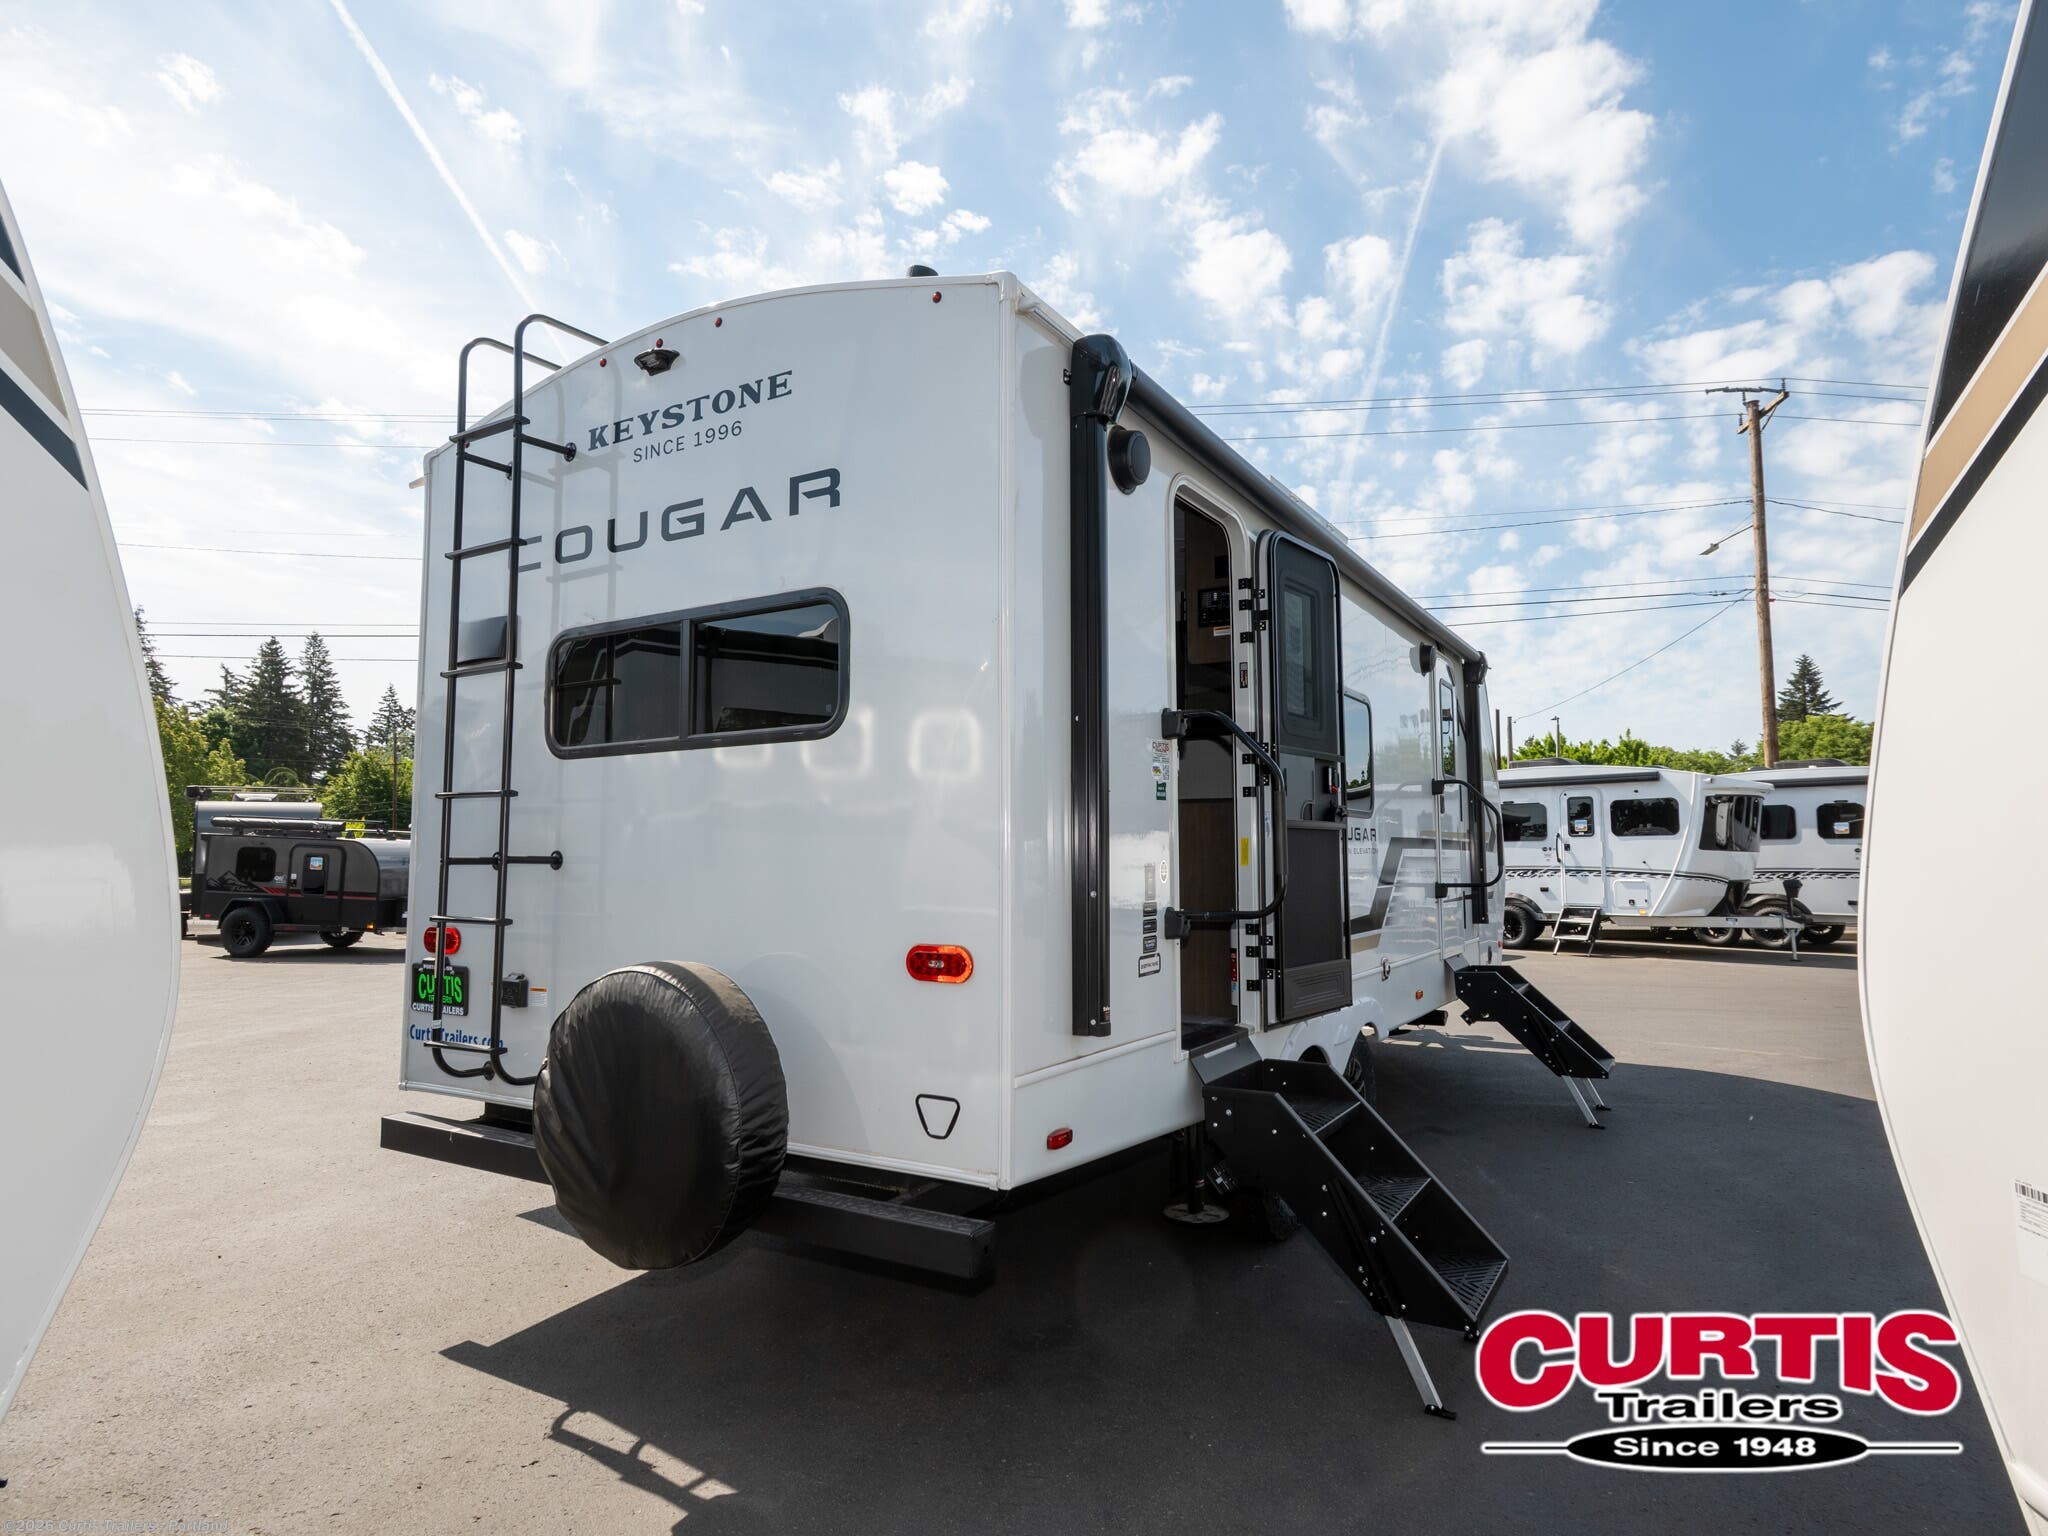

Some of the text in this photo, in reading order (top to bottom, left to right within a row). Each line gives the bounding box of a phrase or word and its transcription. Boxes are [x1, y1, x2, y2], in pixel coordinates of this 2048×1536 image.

[588, 370, 793, 451] KEYSTONE
[633, 420, 742, 463] SINCE 1996
[418, 973, 463, 1003] CUTIS
[428, 995, 453, 1004] TRERS
[441, 1005, 464, 1016] AILERS
